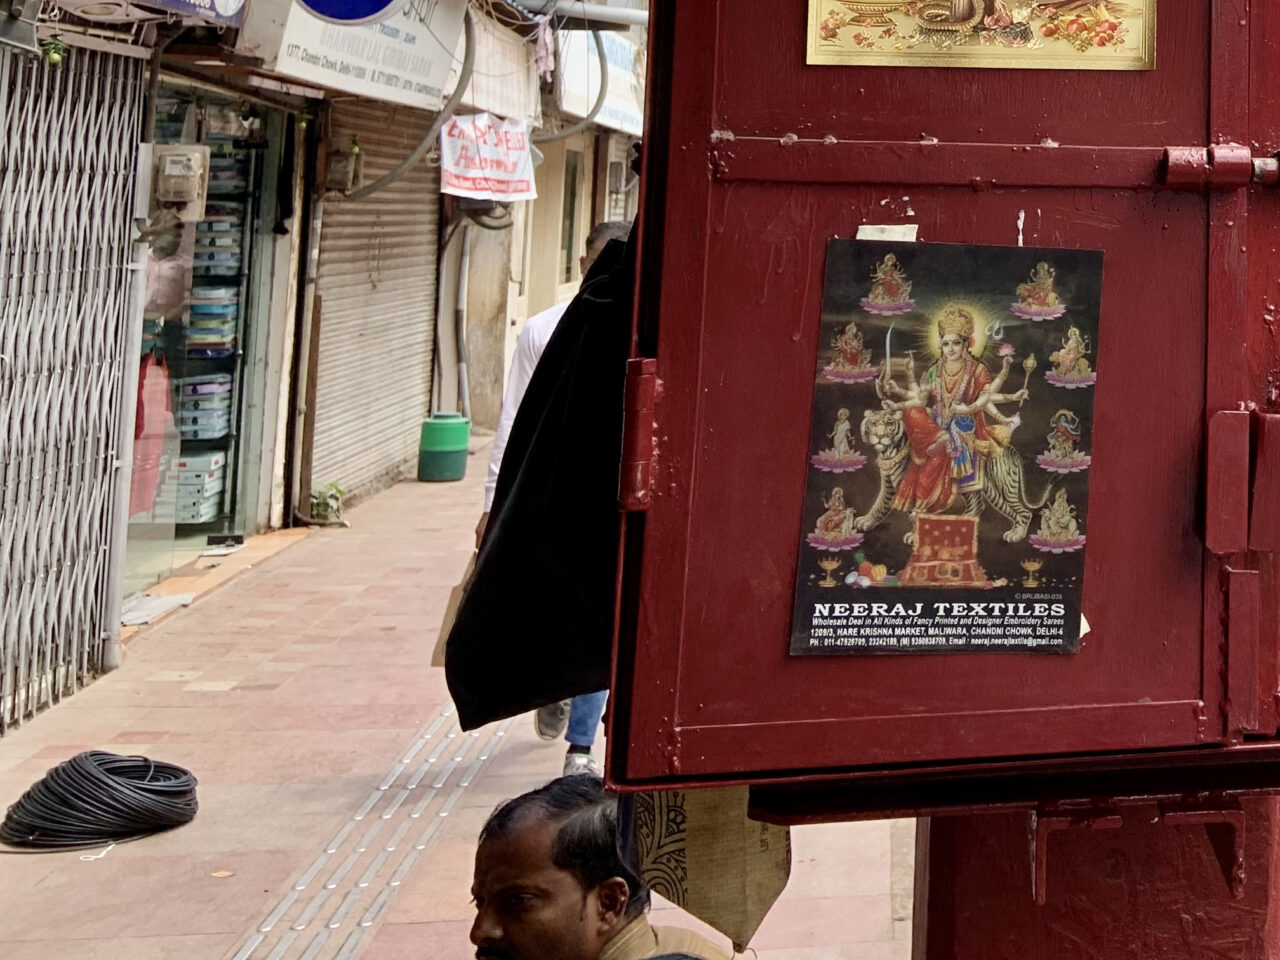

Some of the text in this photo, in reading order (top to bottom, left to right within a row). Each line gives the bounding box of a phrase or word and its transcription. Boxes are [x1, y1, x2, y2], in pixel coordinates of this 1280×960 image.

[813, 602, 1065, 617] NEERAJ TEXTILES
[812, 616, 1064, 626] Wholesale Deal in All Kinds of Fancy Printed and Designer Embroidery Sarees
[810, 627, 1063, 637] 1209/3, HARE KRISHNA MARKET, MALIWARA, CHANDNI CHOWK, DELHI-6
[809, 638, 819, 647] PH
[900, 637, 910, 647] (M)
[949, 637, 966, 645] Email
